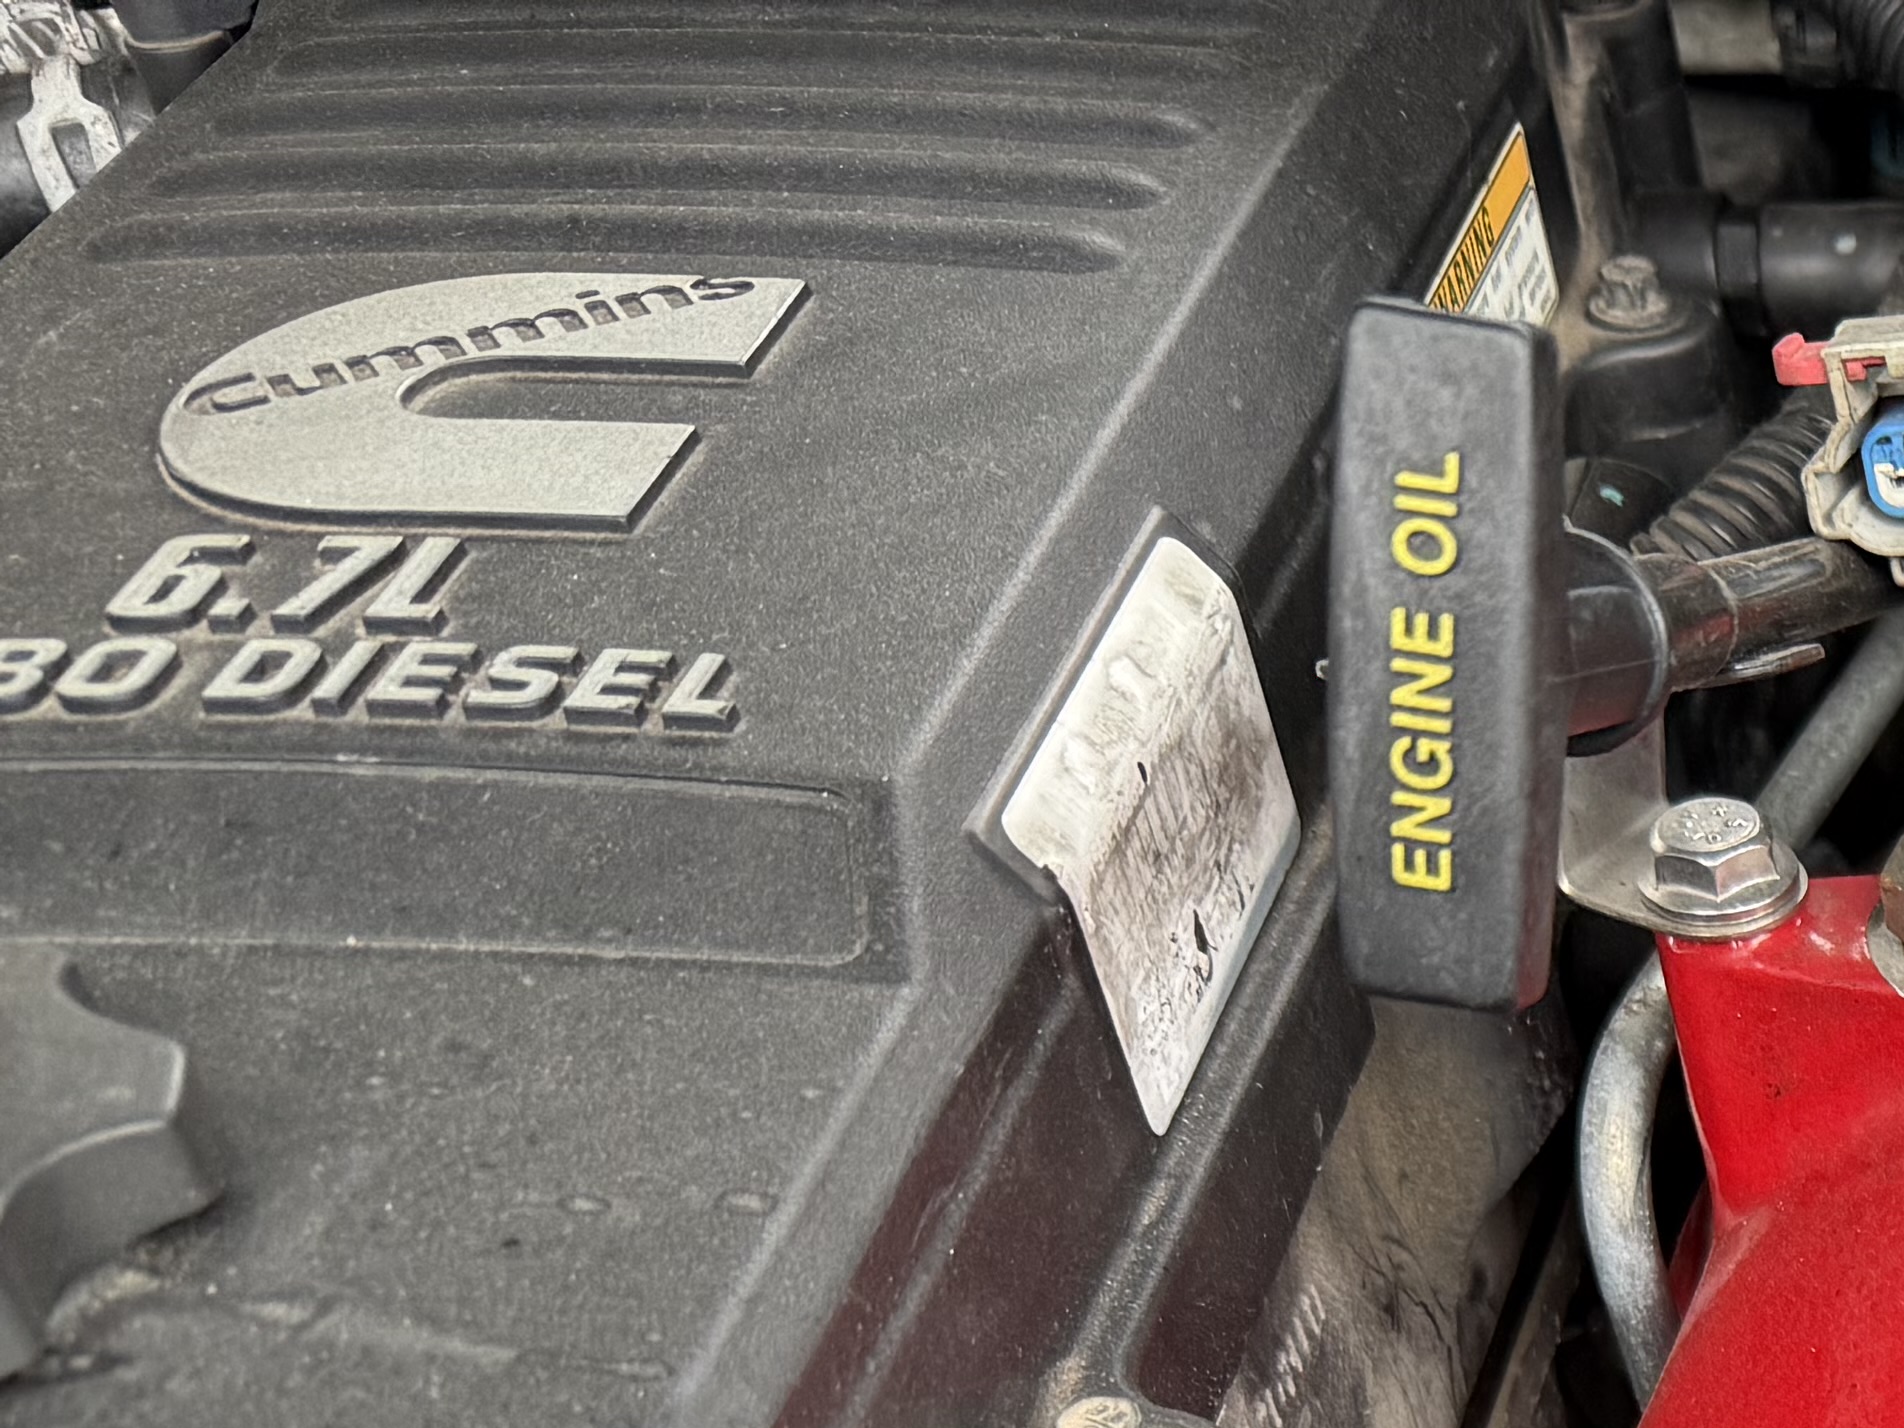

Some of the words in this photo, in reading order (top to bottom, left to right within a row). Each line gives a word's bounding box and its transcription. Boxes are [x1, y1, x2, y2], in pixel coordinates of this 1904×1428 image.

[1390, 450, 1461, 575] OIL
[104, 533, 472, 634] 6.7L
[201, 638, 740, 735] DIESEL
[1389, 607, 1455, 892] ENGINE
